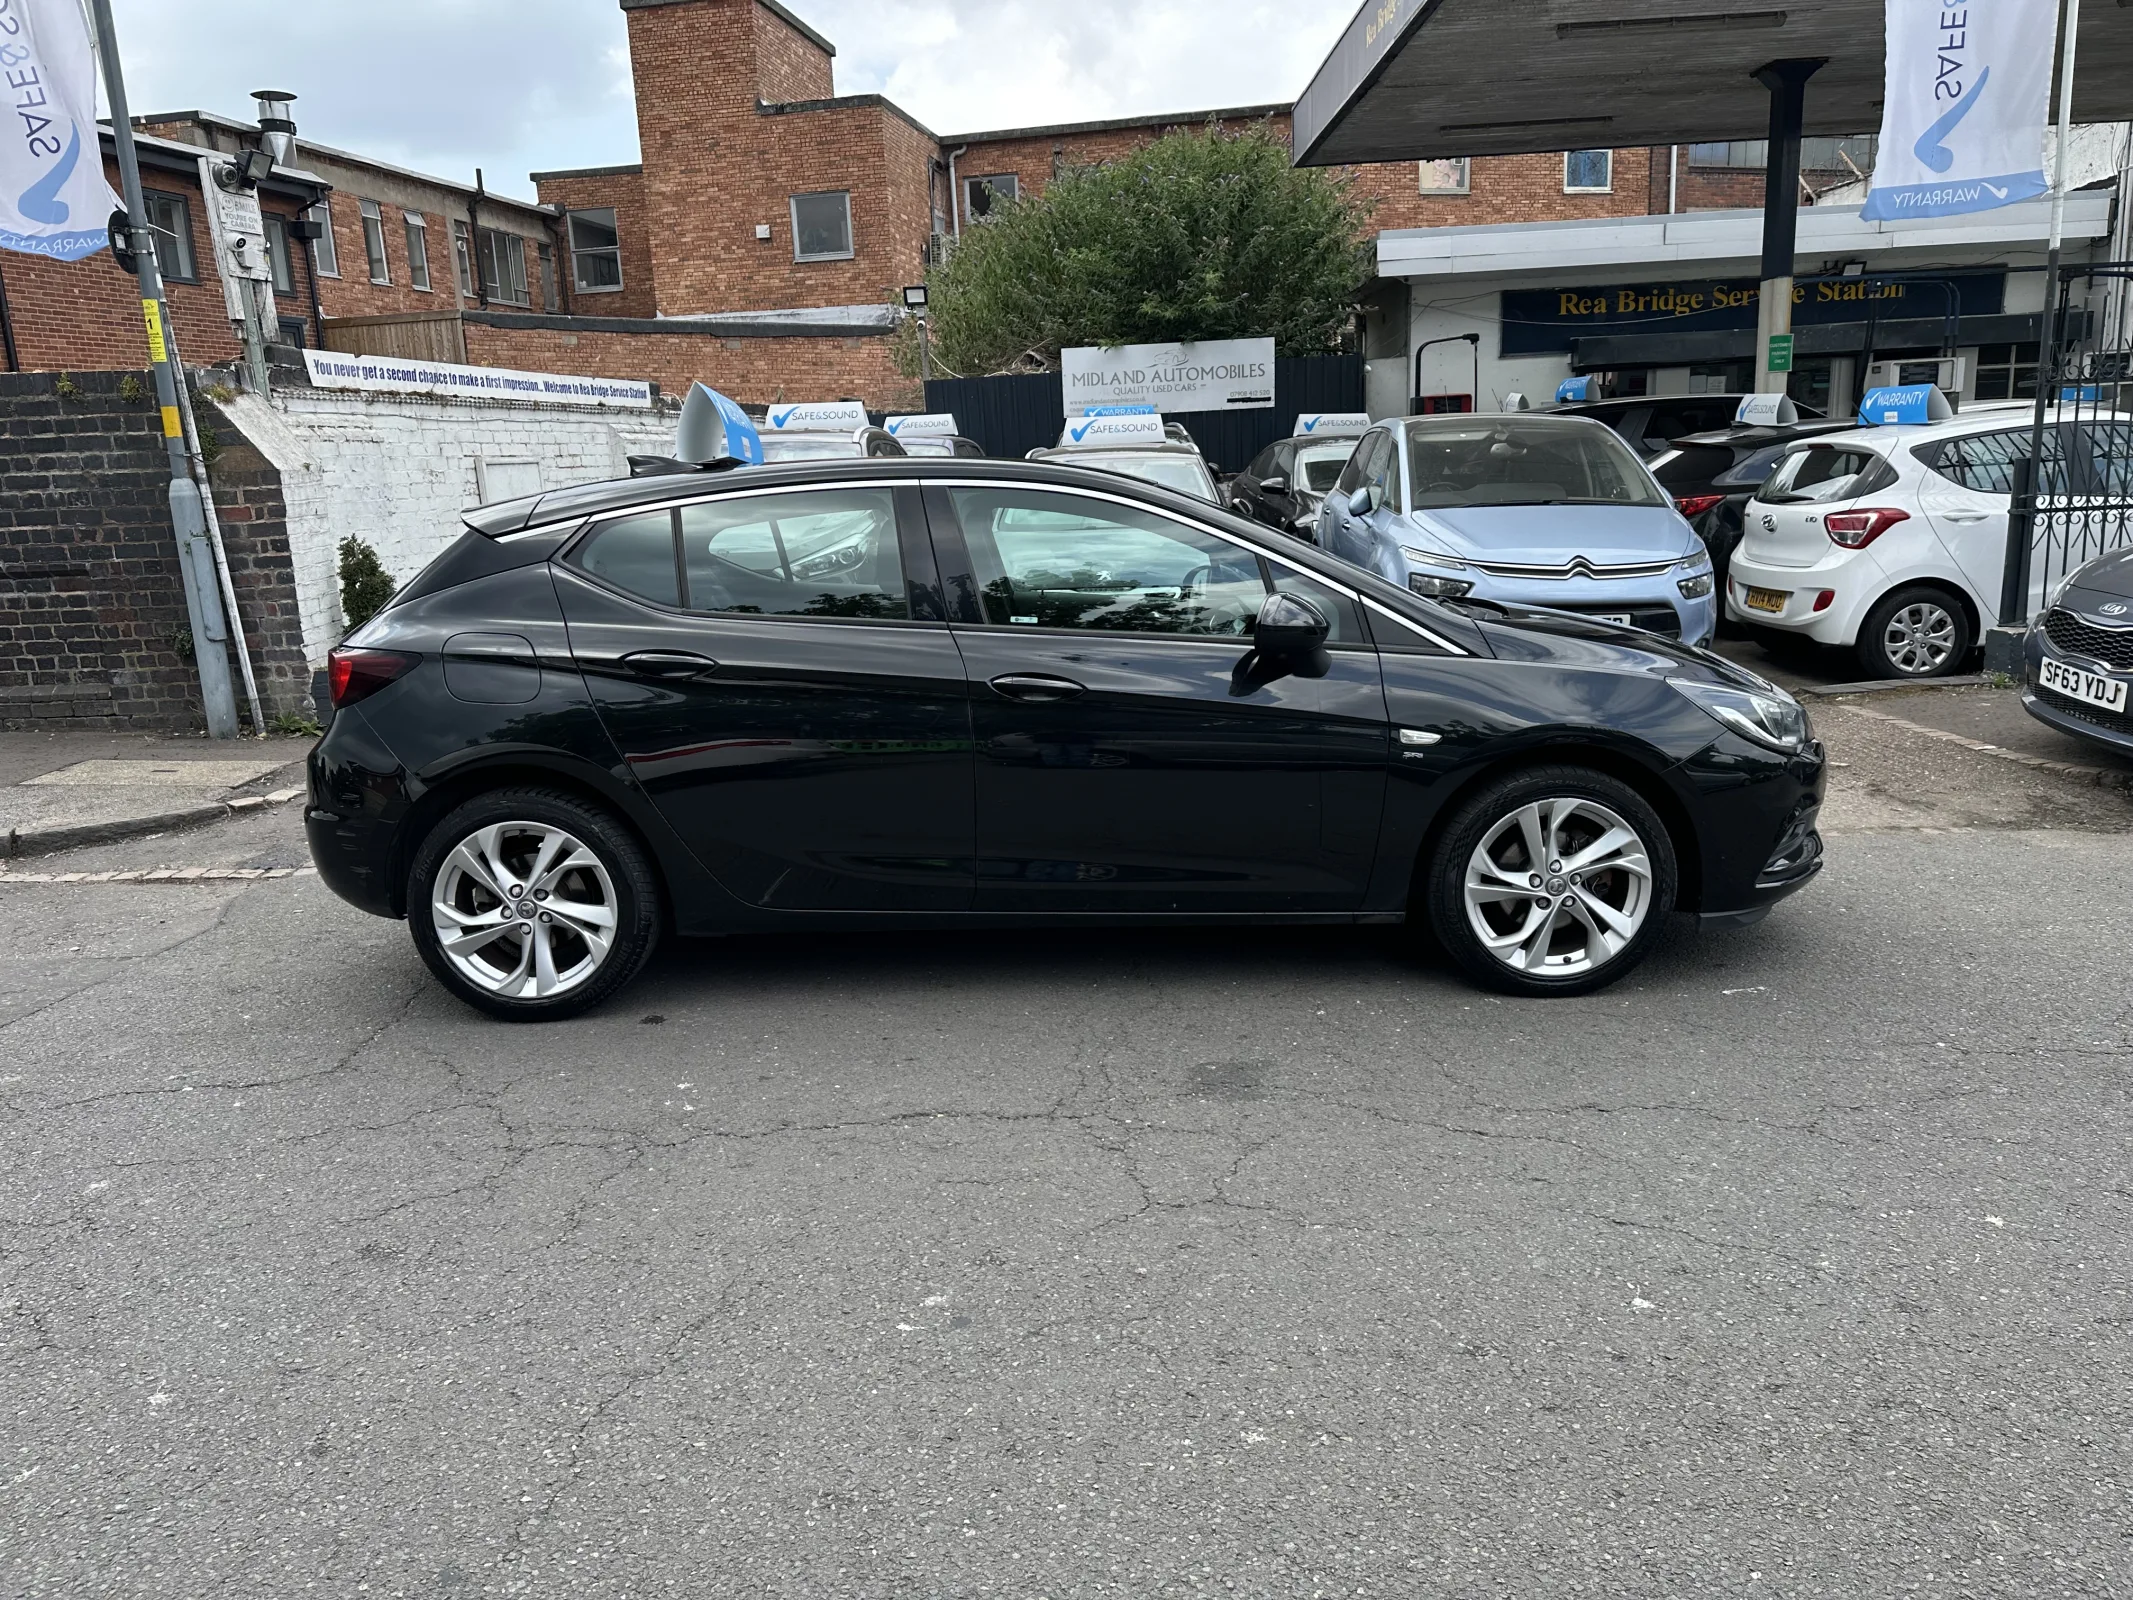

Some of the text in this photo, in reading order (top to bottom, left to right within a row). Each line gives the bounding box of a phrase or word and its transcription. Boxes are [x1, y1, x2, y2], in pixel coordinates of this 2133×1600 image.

[1558, 293, 1608, 316] Rea
[1617, 288, 1705, 317] Bridge
[313, 358, 332, 376] You
[334, 363, 360, 378] never
[362, 366, 378, 381] get
[379, 368, 385, 380] a
[386, 367, 417, 382] second
[418, 369, 448, 384] chance
[449, 371, 457, 385] to
[458, 373, 479, 387] make
[480, 377, 485, 387] a
[486, 375, 501, 388] first
[543, 380, 572, 394] Welcome
[573, 382, 579, 394] to
[579, 383, 590, 395] Rea
[591, 384, 609, 398] Bridge
[609, 386, 629, 398] Service
[629, 387, 647, 399] Station
[1071, 363, 1265, 387] MIDLAND AUTOMOBILES
[1113, 383, 1197, 396] QUALITY USED CARS
[1877, 391, 1926, 407] WARRANTY
[791, 410, 859, 421] SAFE&SOUND
[902, 420, 949, 429] SAFE&SOUND
[1090, 422, 1158, 434] SAFE&SOUND
[1318, 419, 1367, 427] SAFE&SOUND
[1805, 515, 1818, 523] i10
[2101, 605, 2121, 613] KIA
[2045, 661, 2120, 704] SF63 YDJ
